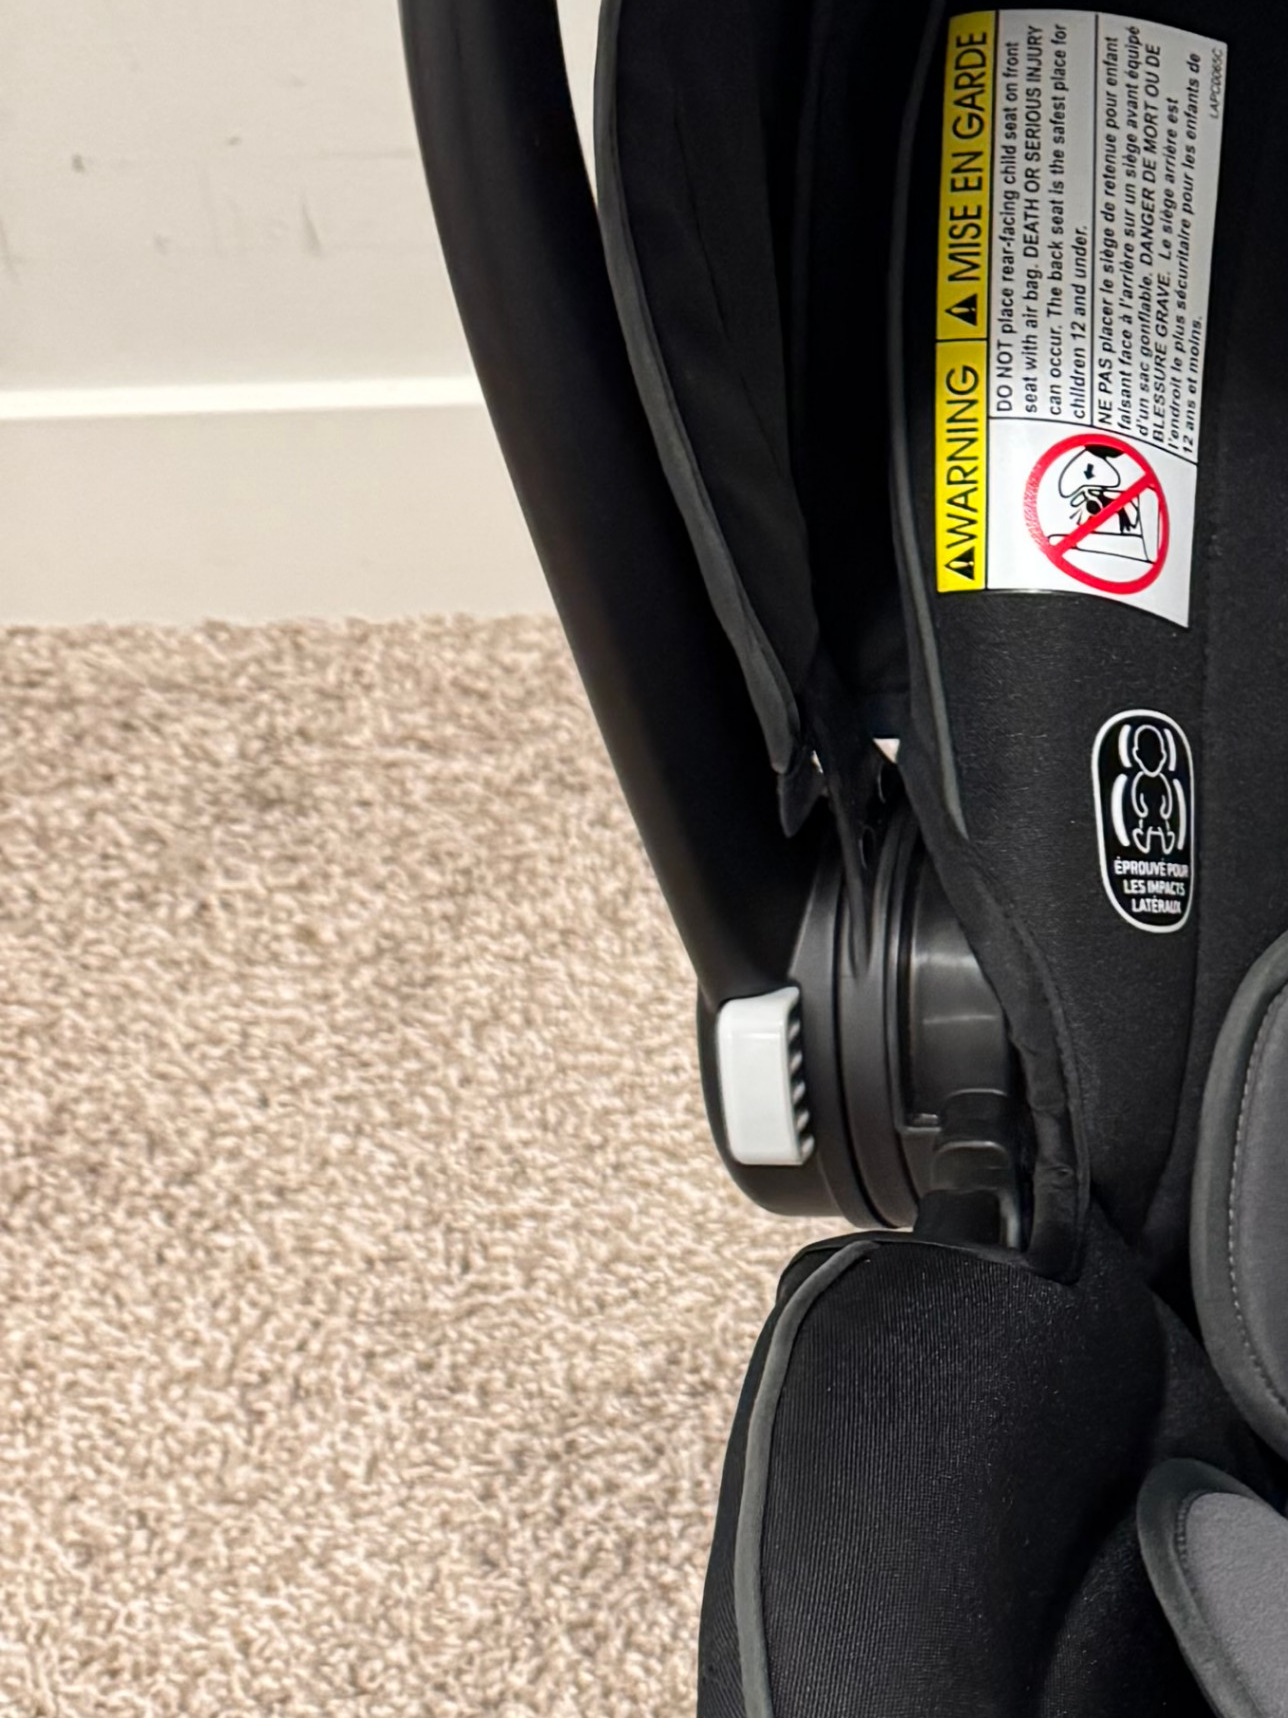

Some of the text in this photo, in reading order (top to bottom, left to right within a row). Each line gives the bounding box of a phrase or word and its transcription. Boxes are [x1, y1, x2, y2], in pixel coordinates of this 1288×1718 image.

[946, 30, 988, 283] MISE EN GARDE
[996, 40, 1020, 412] DO NOT place rear-facing child seat on front
[1021, 24, 1044, 414] seat with air bag. DEATH OR SERIOUS INJURY
[1046, 23, 1070, 416] can occur. The back seat is the safest place for
[1069, 225, 1088, 420] children 12 and under.
[1097, 36, 1121, 426] NE PAS placer le siège de retenue pour enfant
[1116, 25, 1143, 431] faisant face à l'arrière sur un siège avant équipé
[1135, 43, 1161, 437] d'un sac gonflable. DANGER DE MORT OU DE
[1151, 96, 1180, 443] BLESSURE GRAVE. Le siège arrière est
[1167, 52, 1201, 450] l'endroit le plus sécuritaire pour les enfants de
[945, 364, 980, 549] WARNING
[1182, 315, 1203, 454] 12 ans et moins.
[1113, 856, 1189, 877] ÉPROUVÉ POUR
[1123, 879, 1186, 896] LES IMPACTS
[1131, 895, 1182, 914] LATÉRAUX
